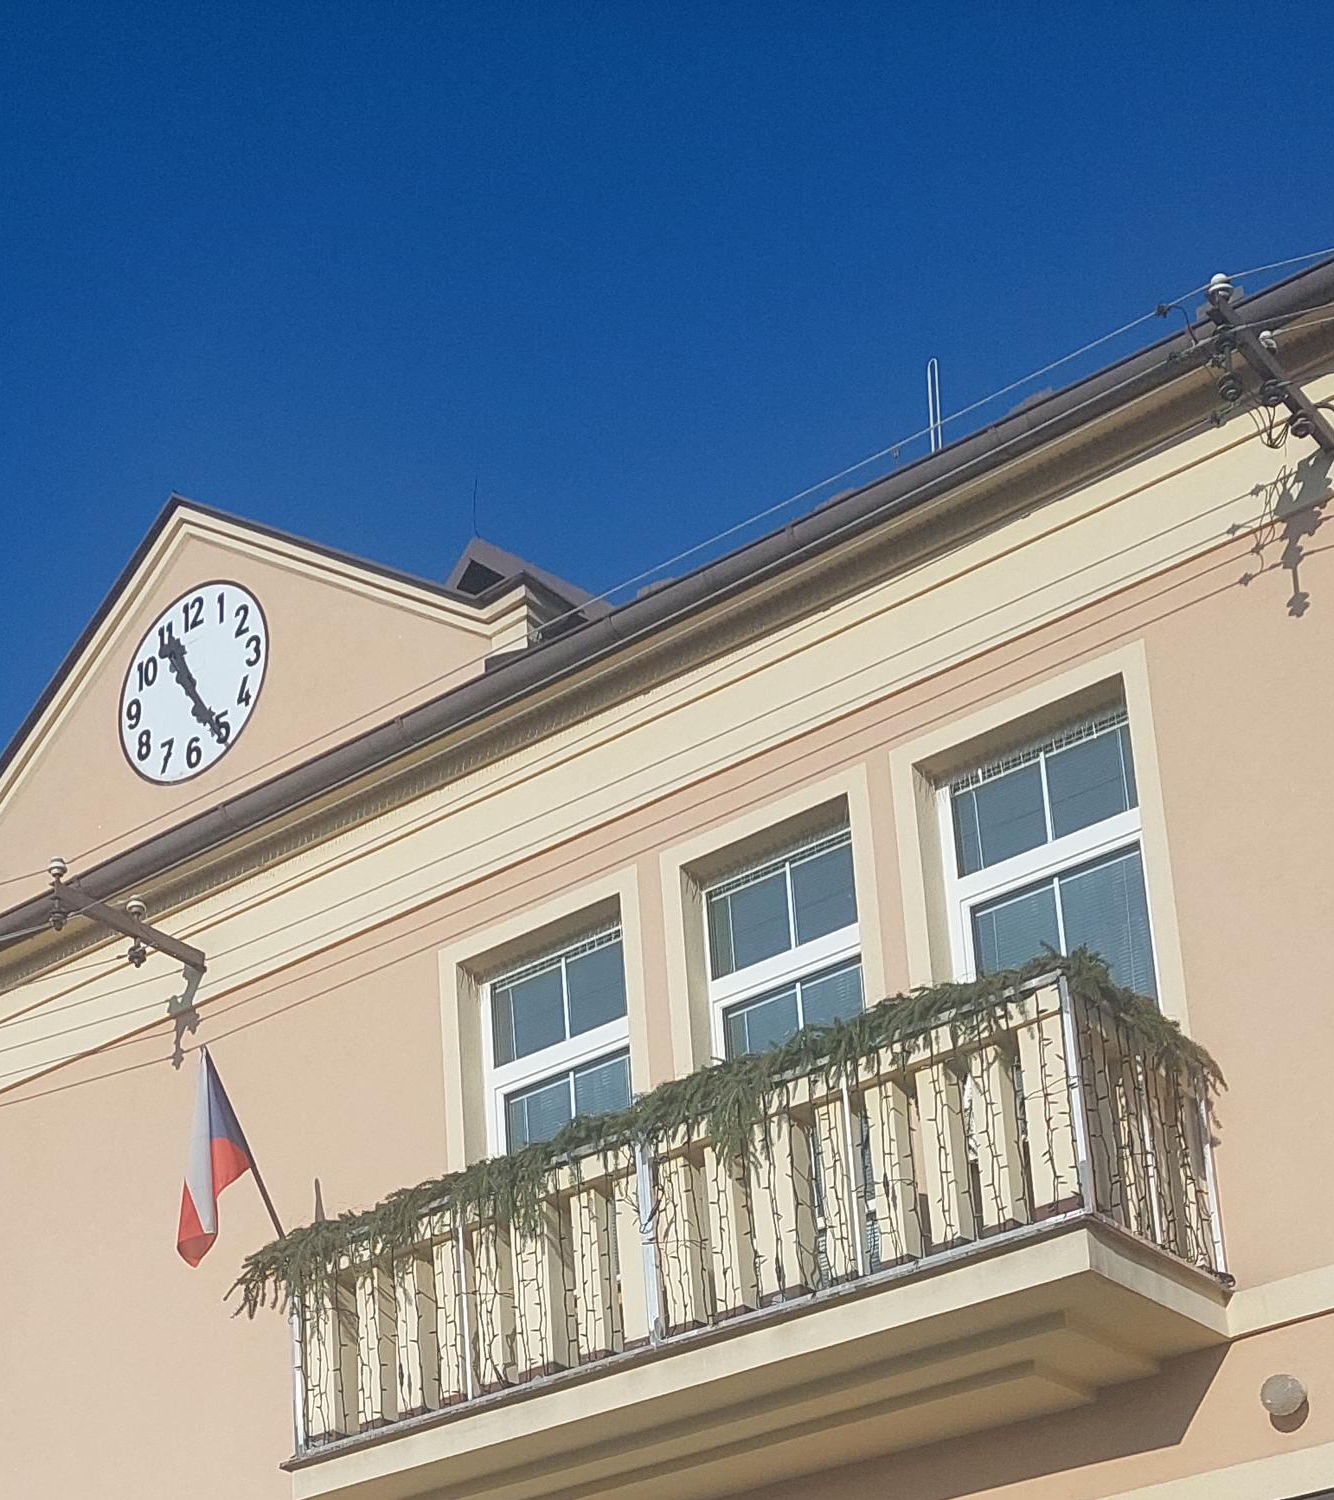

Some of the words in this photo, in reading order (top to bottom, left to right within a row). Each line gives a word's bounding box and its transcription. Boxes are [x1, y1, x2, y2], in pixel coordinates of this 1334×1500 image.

[182, 596, 204, 633] 12
[217, 592, 225, 625] 1
[234, 604, 249, 639] 2
[245, 635, 261, 667] 3
[137, 656, 158, 693] 10
[237, 674, 252, 707] 4
[126, 698, 142, 730] 9
[215, 709, 231, 744] 5
[137, 729, 151, 761] 8
[160, 737, 175, 775] 7
[186, 736, 202, 769] 6
